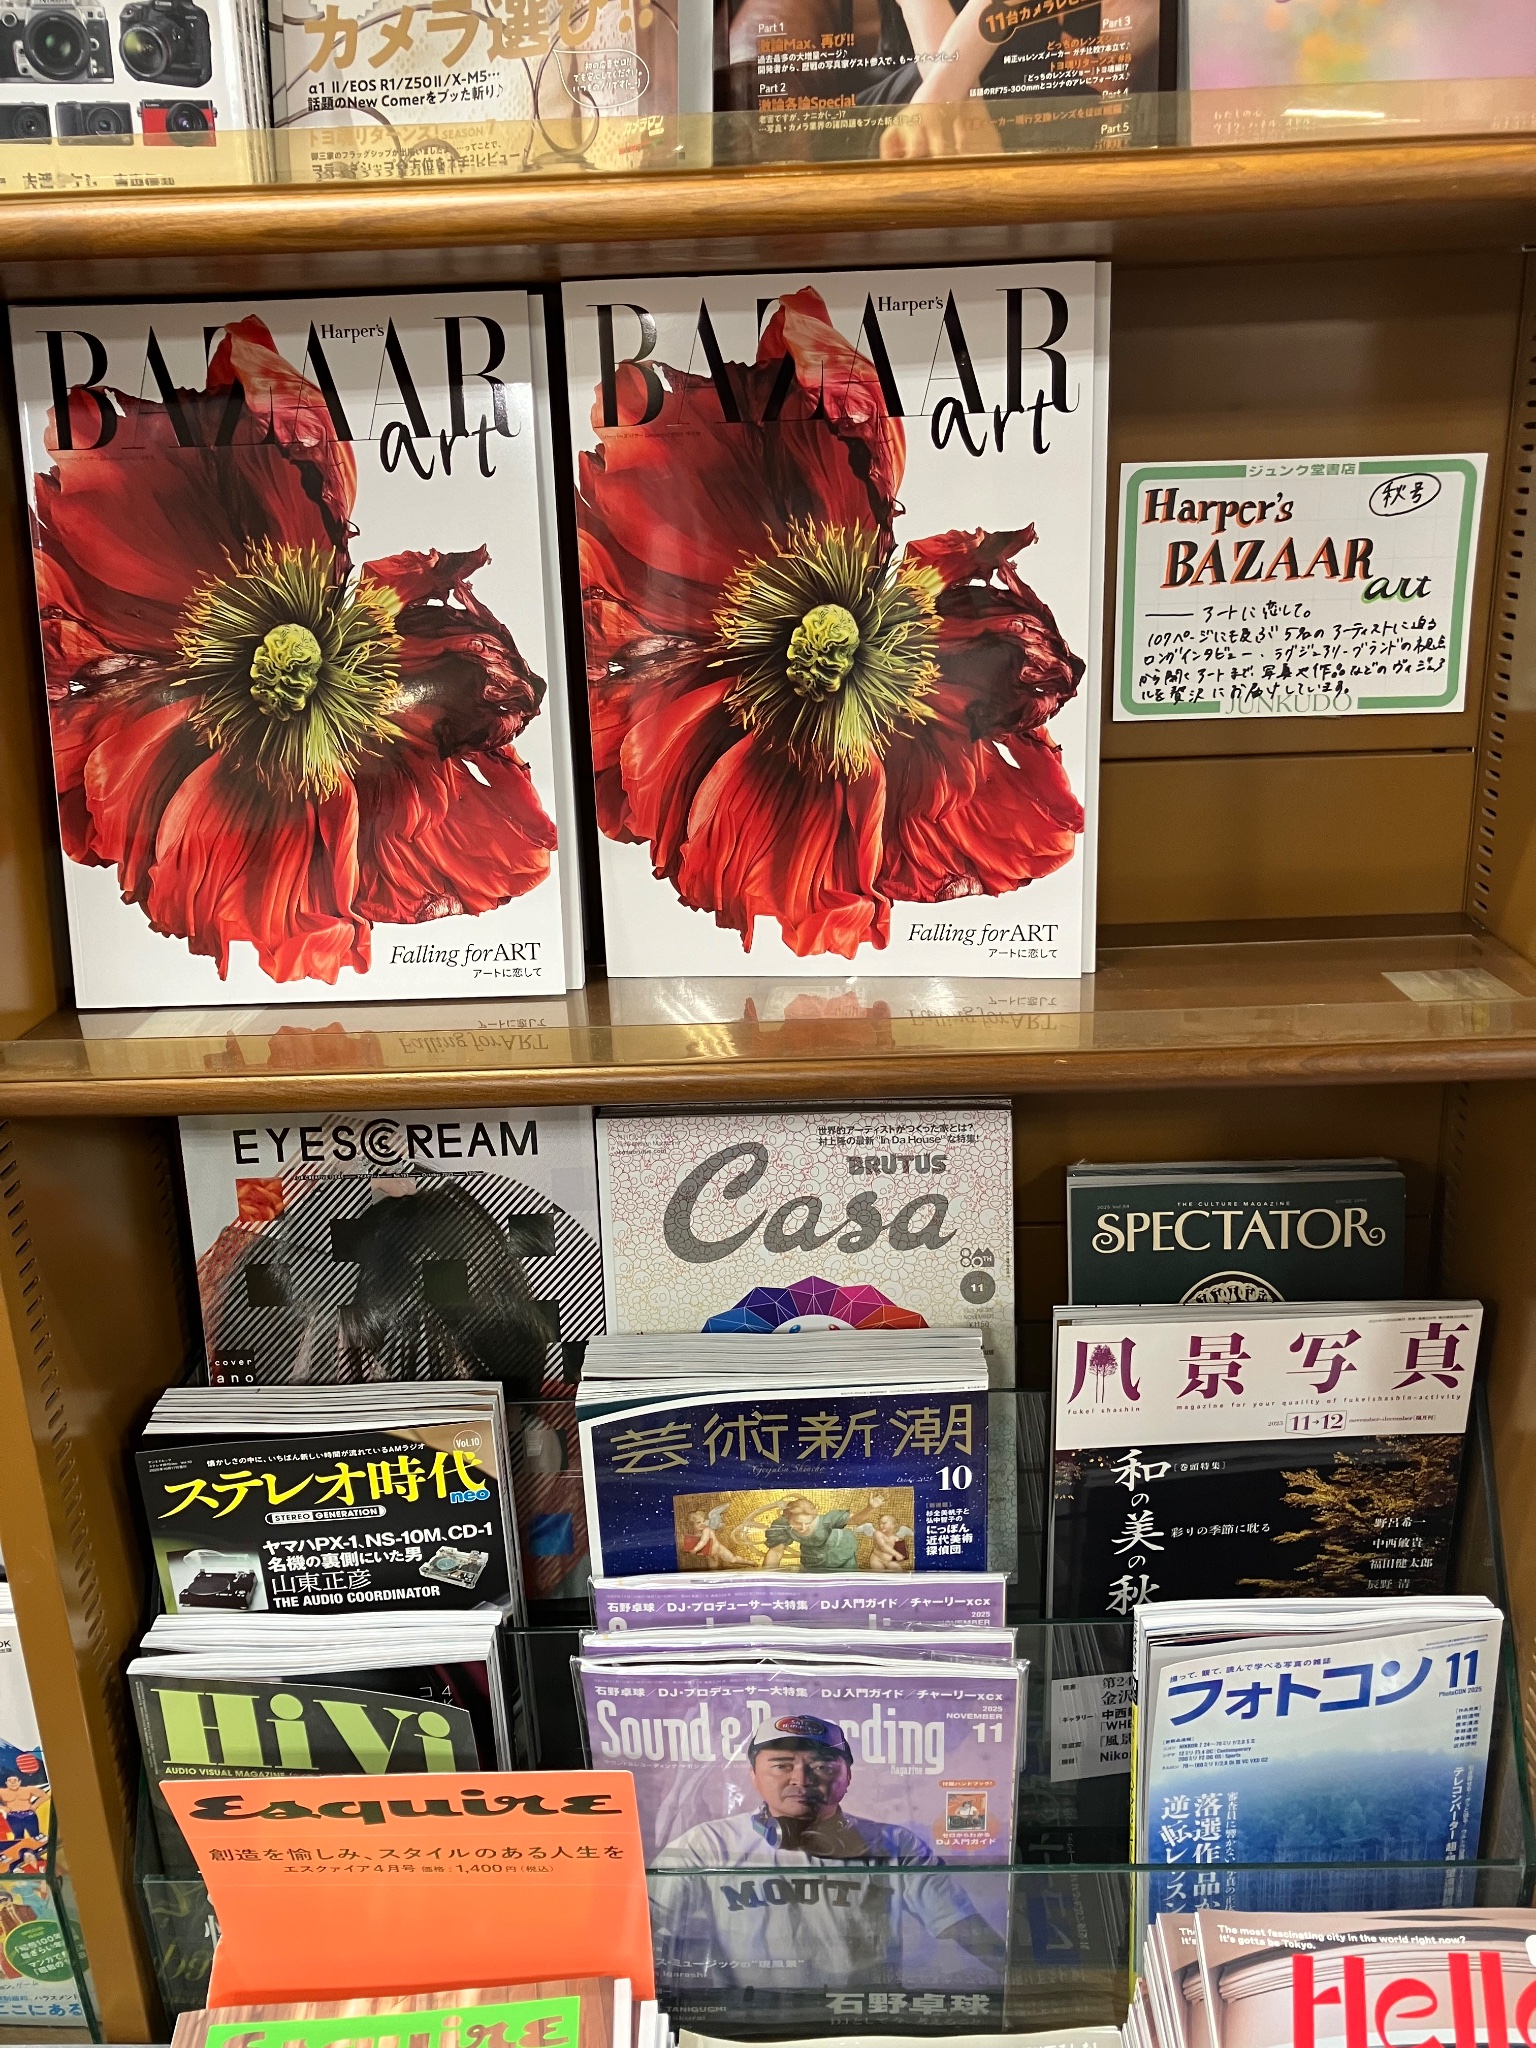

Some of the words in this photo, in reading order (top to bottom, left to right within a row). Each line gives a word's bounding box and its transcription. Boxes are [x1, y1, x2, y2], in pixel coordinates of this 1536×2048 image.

[758, 23, 777, 34] Part
[779, 22, 785, 32] 1
[1102, 18, 1120, 30] Part
[1124, 16, 1131, 26] 3
[759, 83, 779, 94] Part
[780, 82, 786, 92] 2
[1102, 90, 1120, 100] Part
[1101, 124, 1120, 136] Part
[1122, 122, 1129, 132] 5
[877, 294, 944, 317] Harper's
[320, 323, 386, 344] Harper's
[586, 287, 1081, 429] BAZAAR
[36, 316, 521, 450] BAZAAR
[930, 389, 1057, 457] art
[379, 414, 499, 481] art
[1249, 463, 1356, 477] ジュンク堂書店
[1382, 480, 1425, 508] 秋号
[1142, 487, 1294, 535] Harper's
[1160, 536, 1374, 589] BAZAAR
[1361, 575, 1432, 605] art
[1225, 693, 1352, 714] JUNKUDO
[908, 924, 976, 945] Falling
[390, 944, 460, 967] Falling
[988, 948, 1058, 958] アートに恋して
[473, 967, 542, 978] アートに恋して
[892, 1135, 906, 1144] Da
[846, 1153, 950, 1176] BRUTUS
[663, 1141, 959, 1264] Casa
[1092, 1207, 1386, 1254] SPECTATOR
[971, 1284, 984, 1292] 11
[214, 1357, 253, 1368] cover
[216, 1372, 254, 1384] ano
[1101, 1406, 1141, 1414] shashin
[1176, 1403, 1225, 1411] magazine
[1252, 1401, 1276, 1409] your
[1282, 1398, 1321, 1406] quality
[455, 1436, 480, 1448] Vol.10
[609, 1403, 974, 1475] 芸術新潮
[157, 1450, 488, 1520] ステレオ時代
[935, 1465, 973, 1492] 10
[450, 1488, 491, 1504] neo
[274, 1512, 312, 1522] STEREO
[315, 1507, 379, 1520] GENERATION
[926, 1522, 970, 1535] にっぽん
[1106, 1447, 1172, 1616] 和の美の秋
[1170, 1522, 1271, 1538] 彩りの季節に耽る
[925, 1533, 974, 1546] 近代美術
[925, 1544, 962, 1556] 探偵団
[267, 1548, 424, 1572] 名機の裏側にいた男
[1370, 1557, 1434, 1570] 福田健太郎
[271, 1568, 373, 1596] 山東正彦
[273, 1597, 300, 1609] THE
[302, 1592, 344, 1607] AUDIO
[346, 1585, 441, 1604] COORDINATOR
[1445, 1649, 1479, 1689] 11
[1167, 1657, 1433, 1727] フォトコン
[1467, 1685, 1483, 1694] 2025
[945, 1712, 1003, 1720] NOVEMBER
[150, 1688, 457, 1775] HiVi
[597, 1699, 716, 1762] Sound
[720, 1716, 748, 1761] &
[971, 1723, 1003, 1743] 11
[165, 1766, 198, 1775] AUDIO
[199, 1768, 233, 1777] VISUAL
[235, 1770, 285, 1778] MAGAZINE
[890, 1765, 923, 1777] Magazine
[188, 1788, 623, 1826] Esquire
[208, 1846, 624, 1862] 創造を愉しみ、スタイルのある人生を
[1217, 1924, 1238, 1934] The
[1239, 1926, 1266, 1937] most
[1267, 1928, 1325, 1943] fascinating
[1326, 1932, 1346, 1944] city
[1347, 1933, 1357, 1942] in
[1359, 1933, 1377, 1944] the
[1378, 1934, 1409, 1945] world
[1411, 1935, 1436, 1947] right
[1438, 1936, 1466, 1945] now?
[1219, 1933, 1236, 1943] It's
[1238, 1935, 1265, 1947] gotta
[1267, 1937, 1281, 1947] be
[1283, 1938, 1317, 1950] Tokyo.
[825, 1992, 990, 2016] 石野卓球
